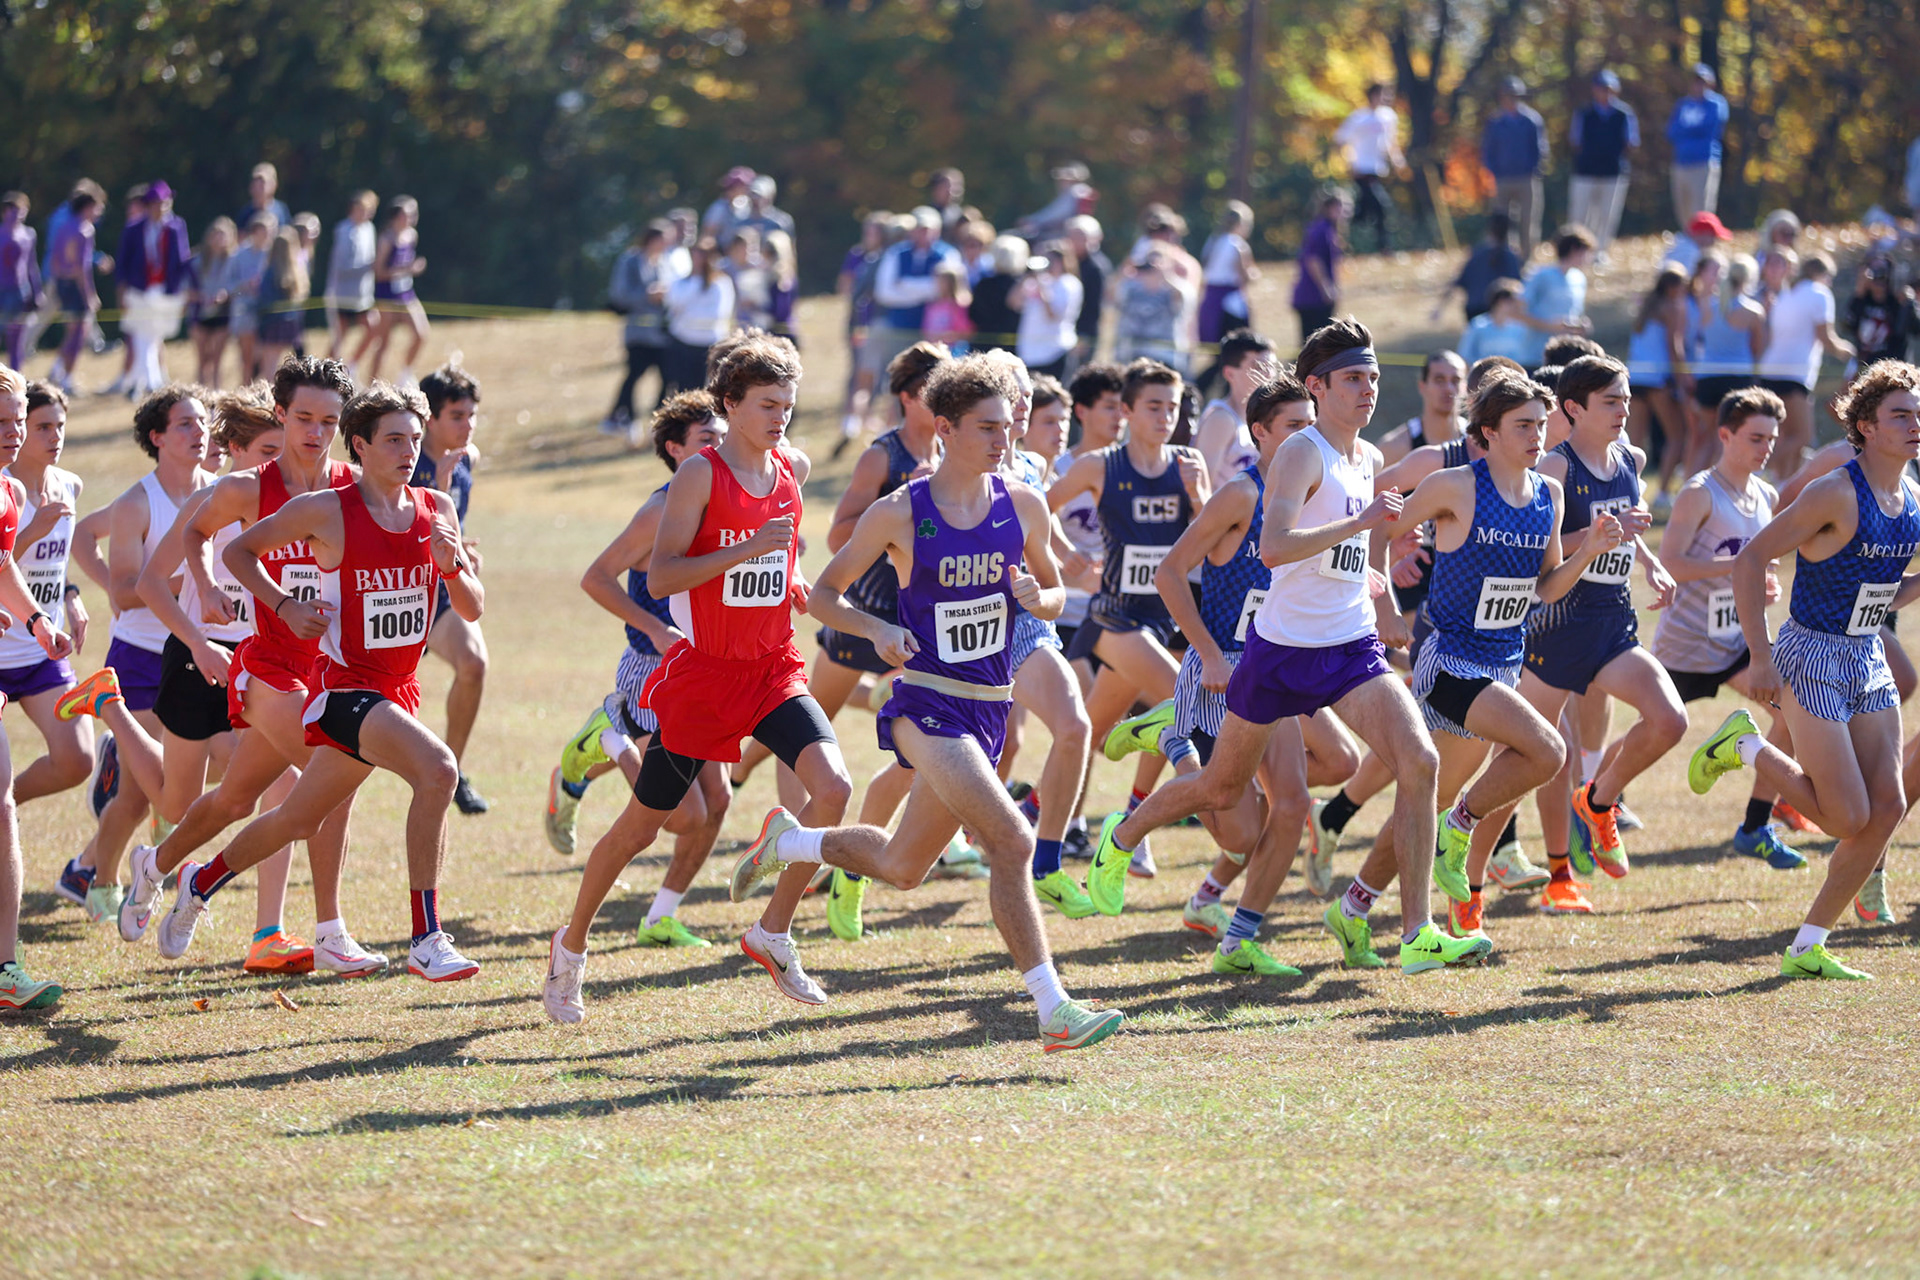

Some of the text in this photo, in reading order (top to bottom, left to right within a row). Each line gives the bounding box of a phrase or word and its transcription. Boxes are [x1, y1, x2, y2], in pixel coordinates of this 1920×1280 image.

[1132, 495, 1180, 524] CCS
[36, 539, 66, 560] CPA
[760, 556, 776, 565] STATE
[290, 571, 313, 580] TMSAA
[938, 551, 1005, 588] CBHS
[27, 582, 61, 605] 064
[224, 584, 244, 593] TMSA
[289, 585, 321, 603] 10
[730, 570, 784, 598] 1009
[372, 598, 398, 608] TMSAA
[398, 595, 417, 605] STATE
[945, 601, 1002, 619] TMSAA STATE XC
[1484, 597, 1528, 621] 1160
[369, 607, 424, 640] 1008
[946, 617, 1000, 653] 1077
